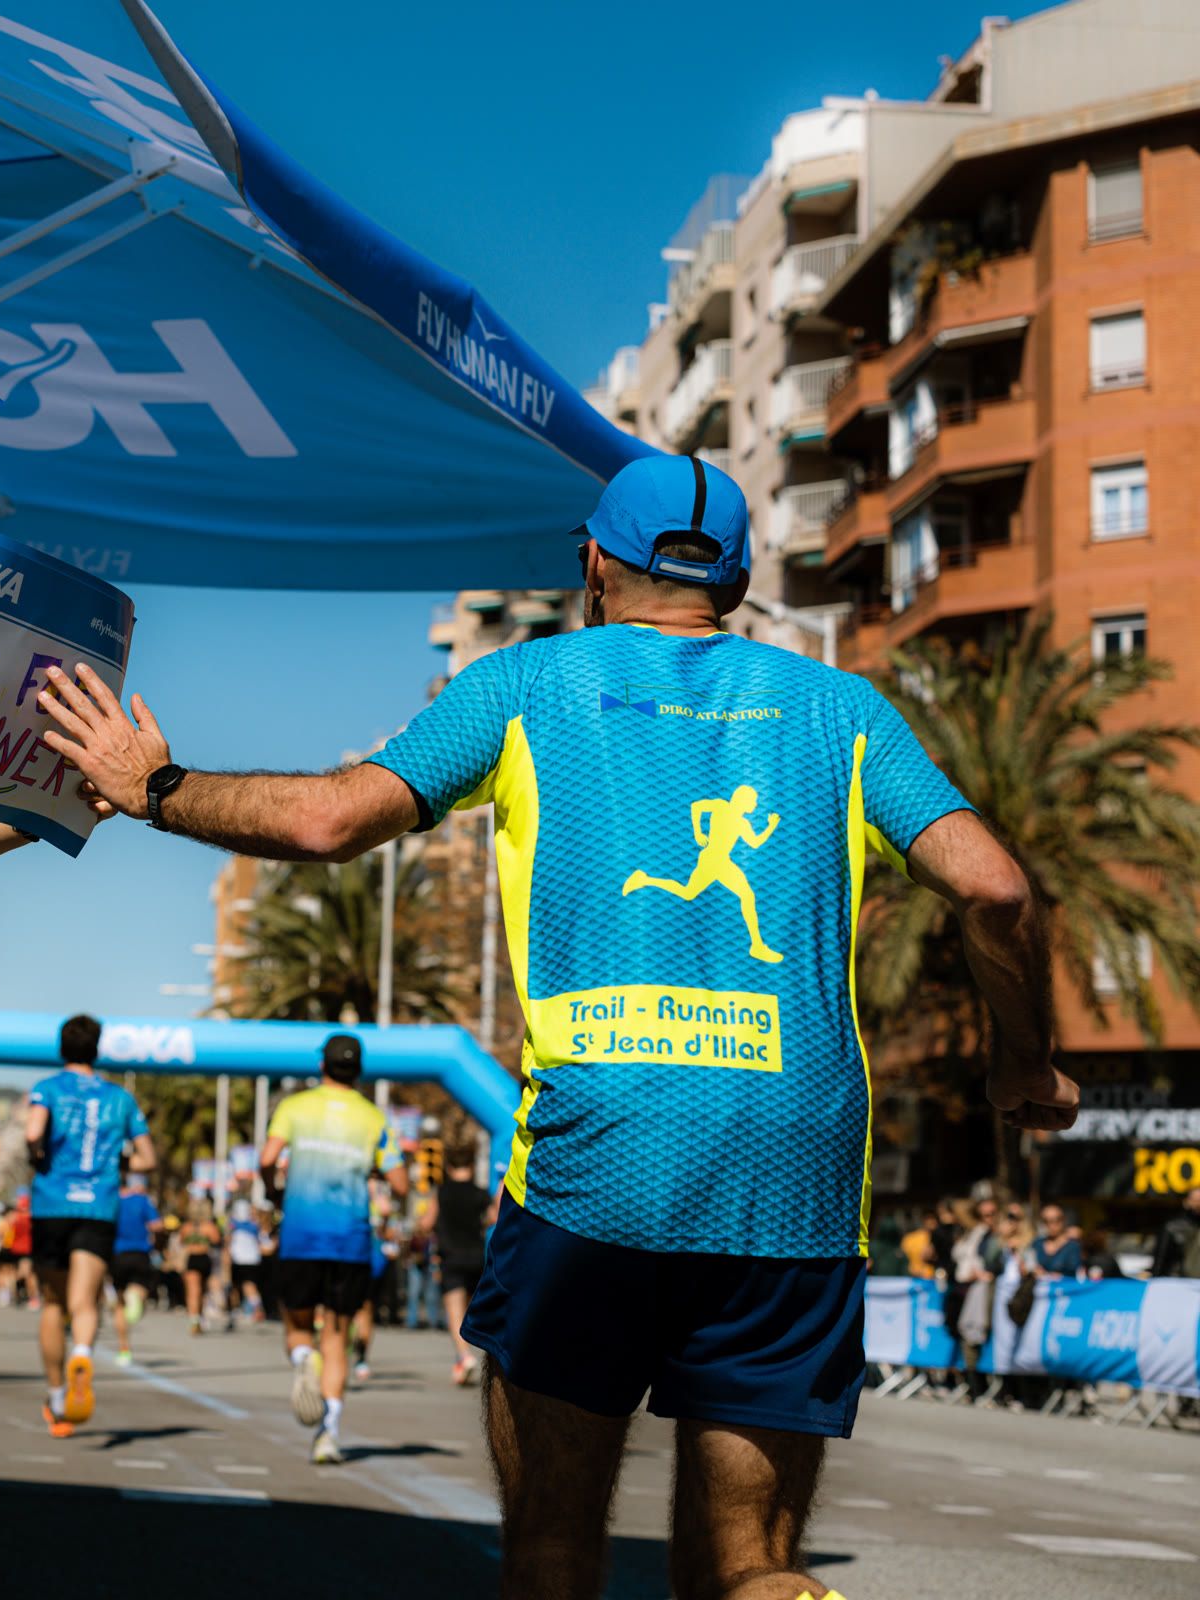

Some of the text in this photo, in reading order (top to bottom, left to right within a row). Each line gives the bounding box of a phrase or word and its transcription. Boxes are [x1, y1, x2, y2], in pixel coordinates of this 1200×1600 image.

[417, 291, 556, 428] FLY HUMAN FLY
[659, 704, 783, 722] DIRO ATLANTIQUE
[569, 995, 625, 1023] Trail
[657, 995, 772, 1035] Running
[603, 1030, 674, 1056] Jean
